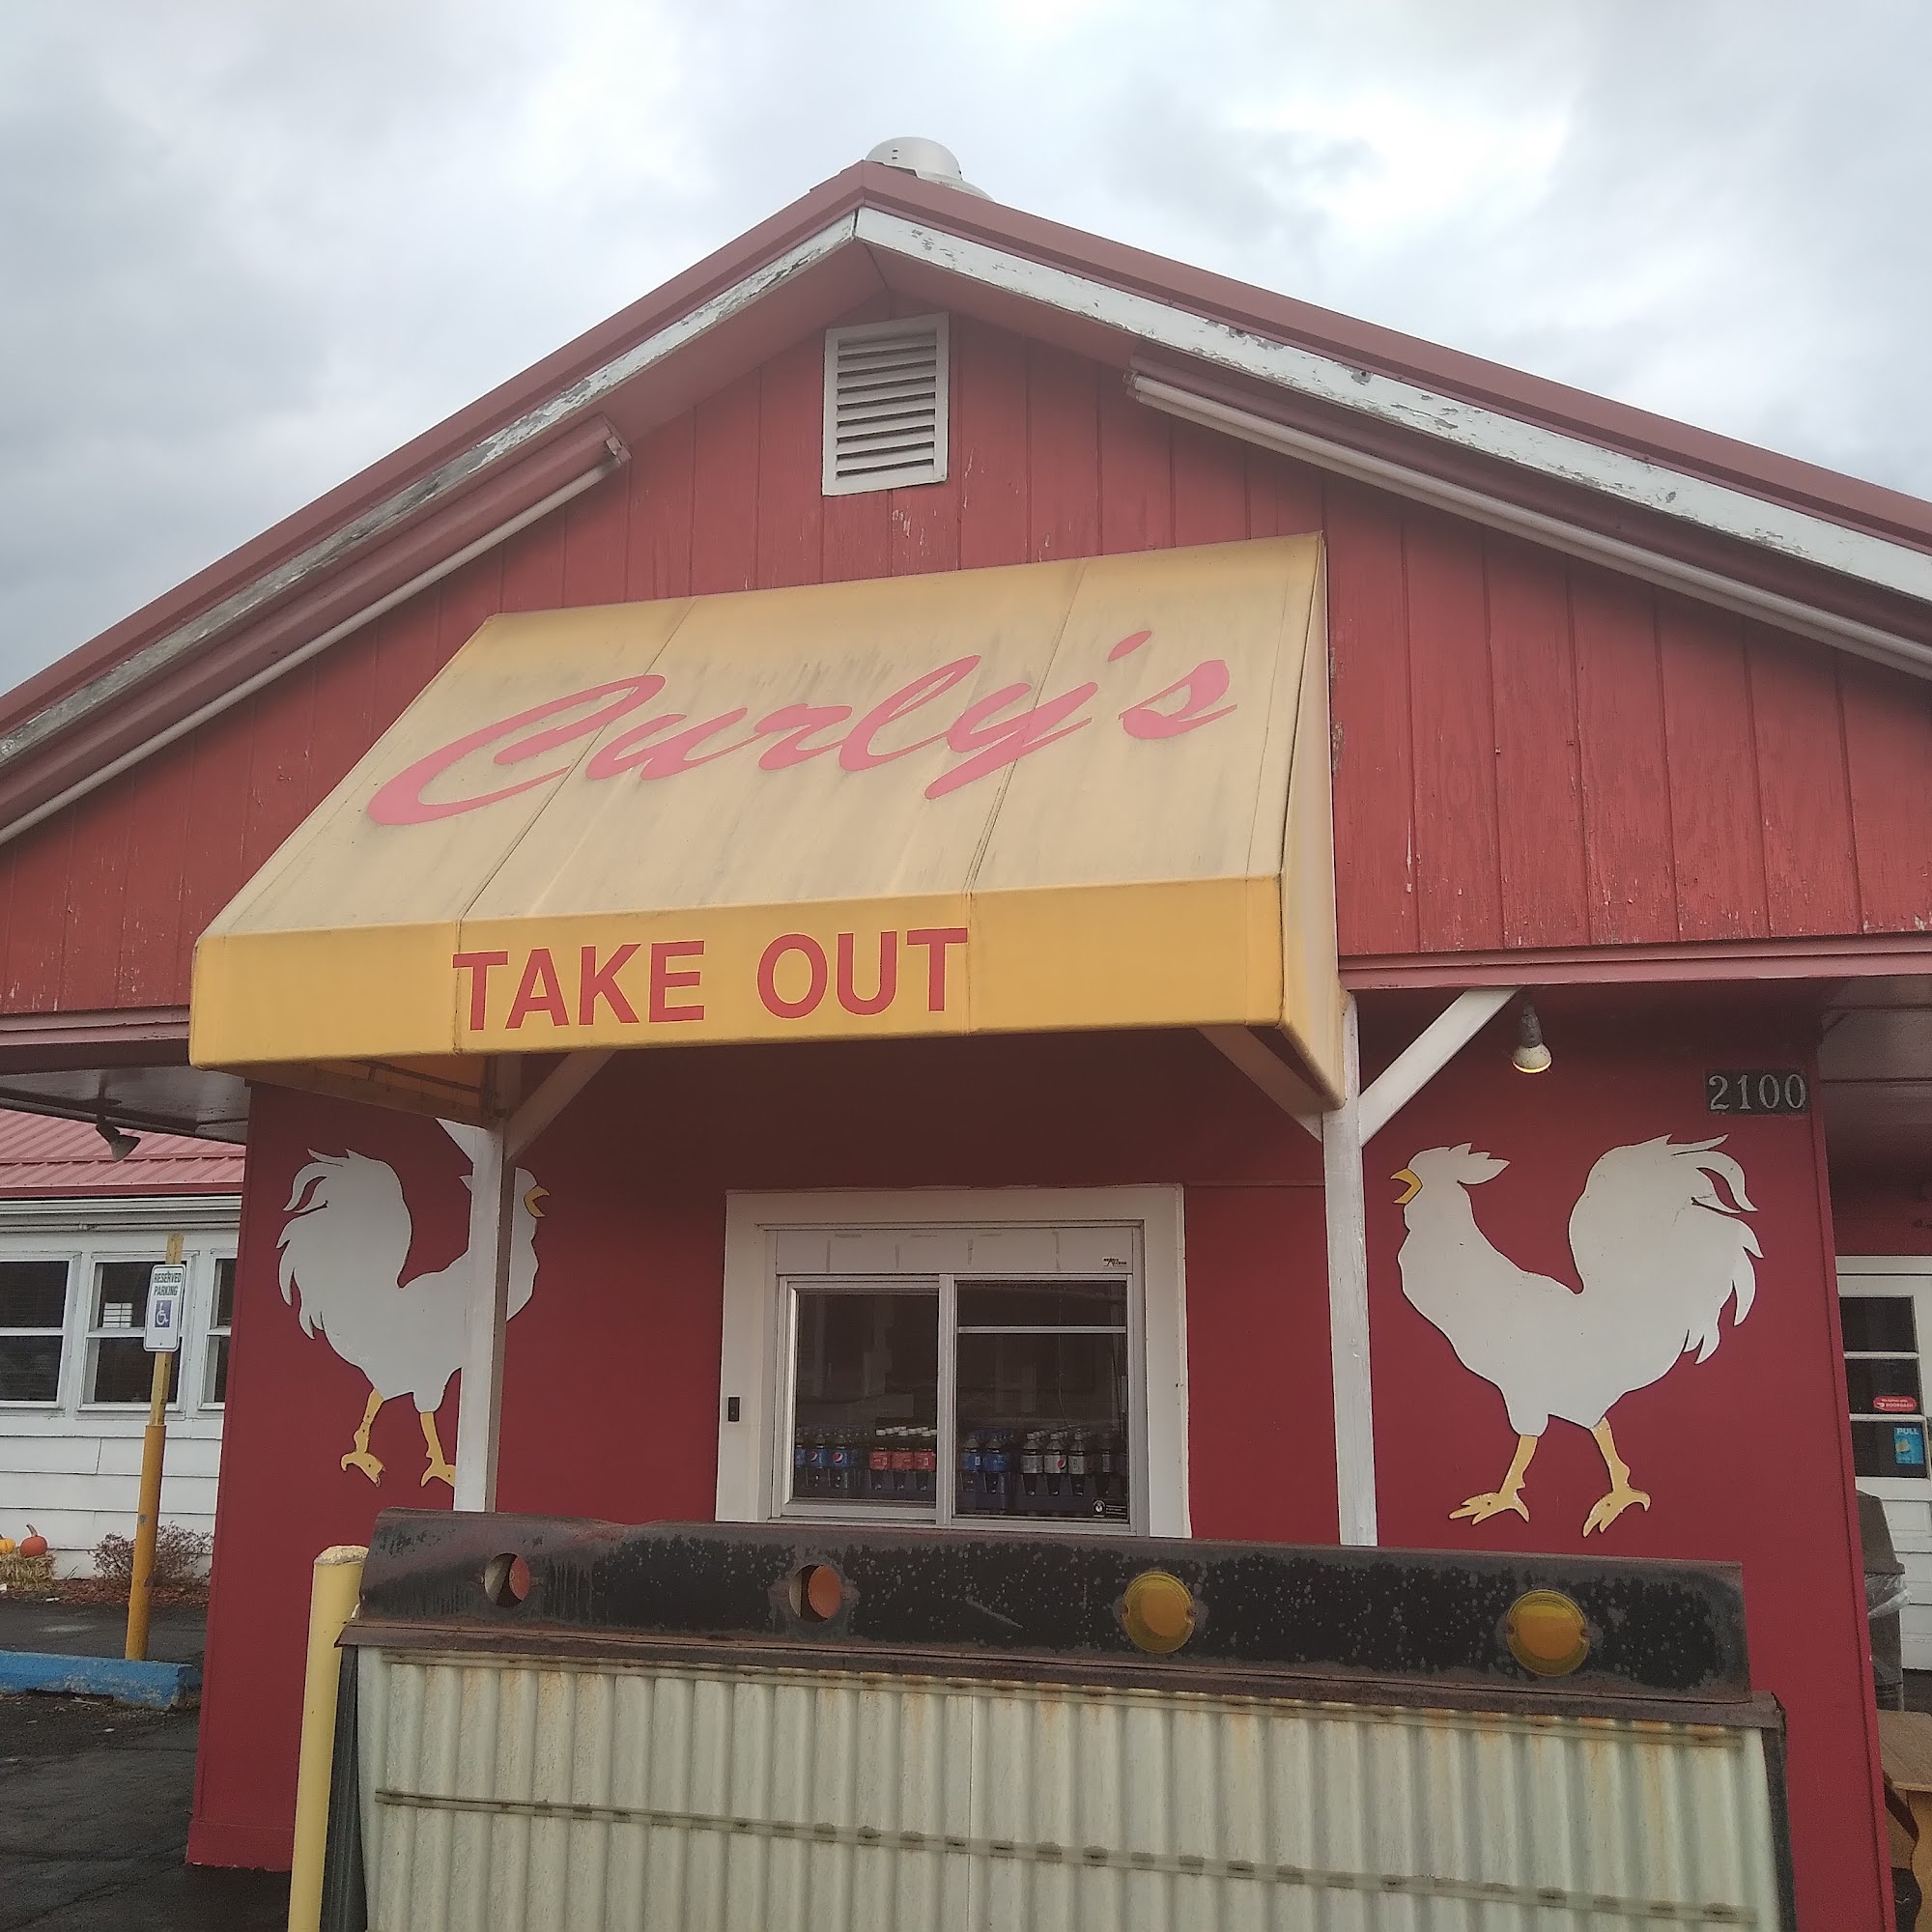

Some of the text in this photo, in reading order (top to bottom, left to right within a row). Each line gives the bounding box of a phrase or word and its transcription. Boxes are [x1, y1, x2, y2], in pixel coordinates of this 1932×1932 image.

[367, 631, 1236, 825] Curly's
[453, 927, 968, 1031] TAKE OUT
[1708, 1073, 1806, 1110] 2100
[155, 1272, 182, 1283] RESERVED
[154, 1285, 179, 1296] PARKING
[1896, 1427, 1920, 1435] PULL
